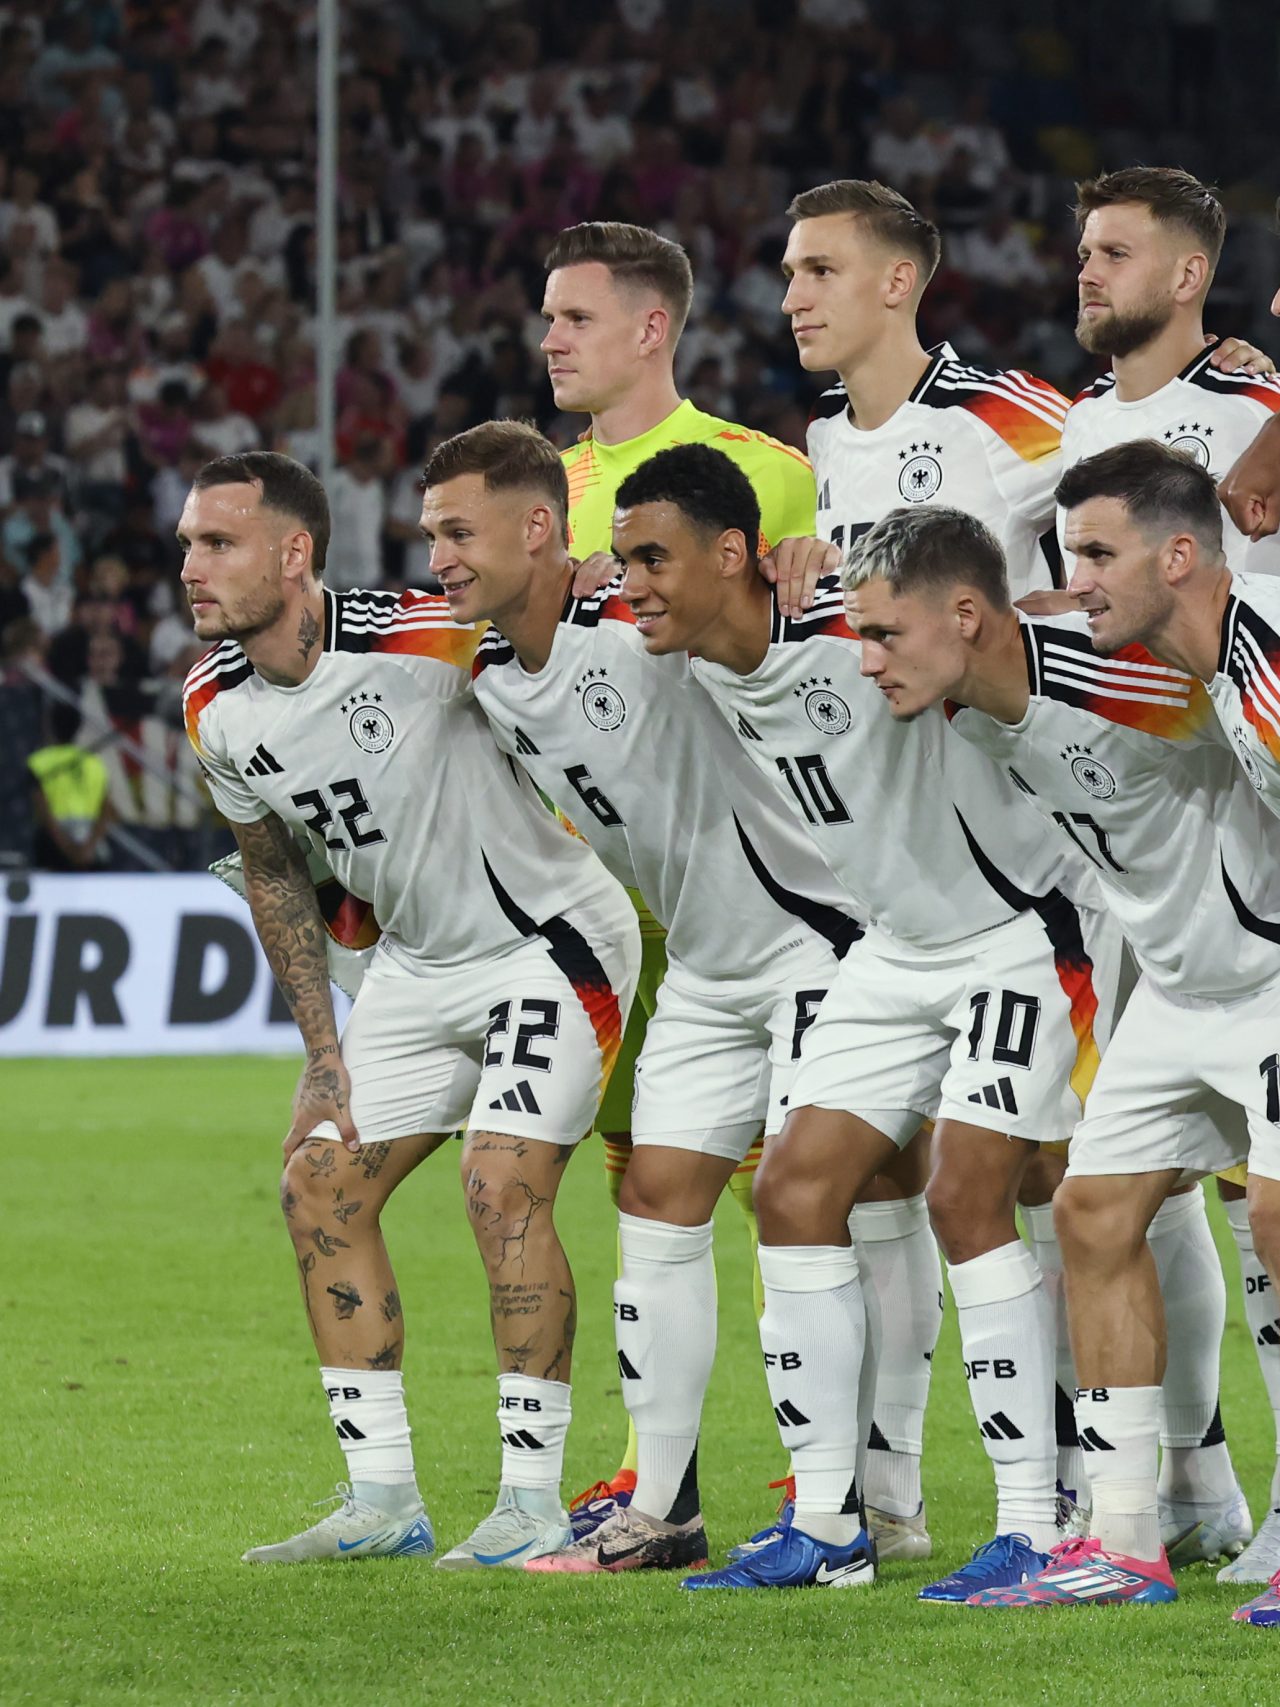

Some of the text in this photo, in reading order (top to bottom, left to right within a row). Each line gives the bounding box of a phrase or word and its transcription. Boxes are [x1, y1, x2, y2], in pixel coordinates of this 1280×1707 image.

[290, 777, 388, 852] 22
[562, 763, 627, 829] 6
[774, 753, 854, 827] 10
[1051, 810, 1129, 875] 17
[484, 998, 562, 1074] 22
[967, 988, 1042, 1071] 10
[1246, 1274, 1273, 1294] DF
[764, 1351, 803, 1371] FB
[325, 1386, 362, 1402] FB
[1074, 1386, 1110, 1403] FB
[1086, 1564, 1144, 1586] F50
